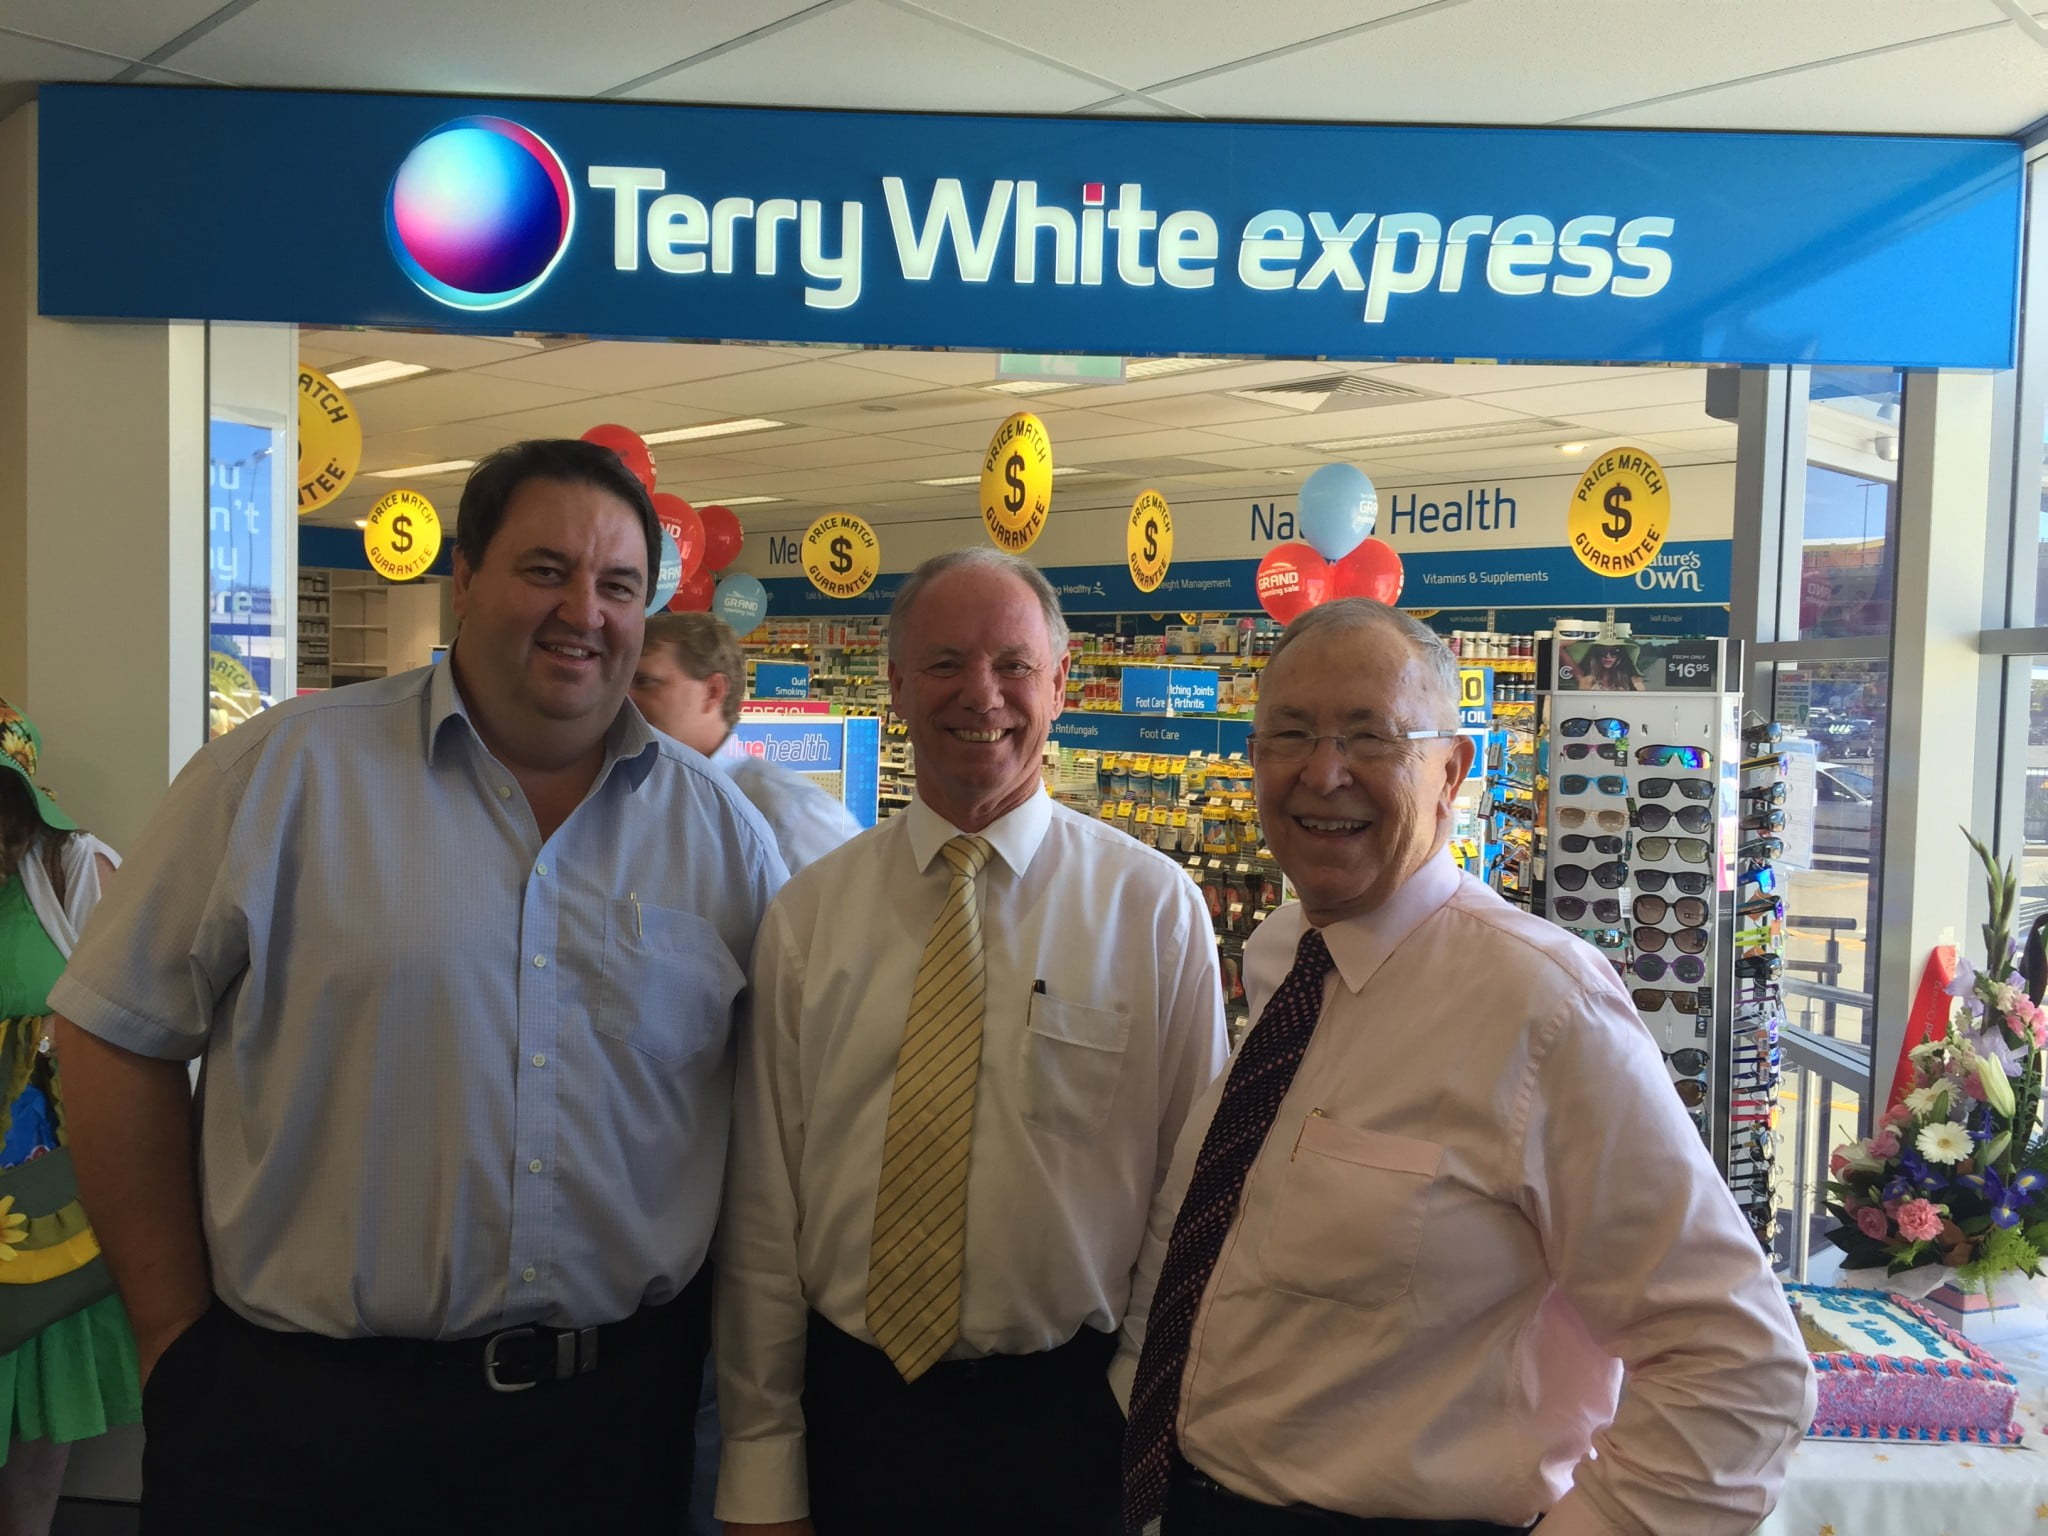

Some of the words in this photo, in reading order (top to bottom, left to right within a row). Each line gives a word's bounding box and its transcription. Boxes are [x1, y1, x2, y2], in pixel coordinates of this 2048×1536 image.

[588, 165, 863, 309] Terry
[882, 176, 1219, 289] White
[1238, 209, 1675, 323] express
[298, 373, 349, 424] ATCH
[986, 423, 1014, 472] PRICE
[1016, 420, 1046, 463] MATCH
[1004, 450, 1025, 516] $
[1577, 457, 1614, 502] PRICE
[1618, 455, 1662, 495] MATCH
[371, 494, 398, 524] PRICE
[401, 493, 433, 524] MATCH
[986, 496, 1045, 547] GUARANTEE
[1132, 495, 1151, 527] PRICE
[1152, 496, 1170, 533] MATCH
[1391, 487, 1516, 535] Health
[1601, 482, 1632, 542] $
[391, 513, 413, 555] $
[808, 517, 838, 545] PRICE
[841, 517, 874, 548] MATCH
[1144, 517, 1158, 564] $
[371, 545, 432, 575] GUARANTEE
[830, 535, 853, 575] $
[1575, 526, 1660, 570] GUARANTEE
[1649, 551, 1701, 568] ature's
[809, 565, 872, 594] GUARANTEE
[1063, 586, 1092, 595] Healthy
[1158, 579, 1180, 591] eight
[1181, 577, 1232, 590] Management
[1258, 572, 1299, 591] GRAND
[1284, 585, 1300, 594] sale
[1423, 573, 1467, 585] Vitamins
[1469, 572, 1478, 583] &
[1480, 570, 1549, 584] Supplements
[1635, 566, 1704, 592] Own
[724, 597, 759, 612] GRAND
[775, 687, 807, 698] Smoking
[791, 676, 807, 686] Quit
[1192, 685, 1215, 697] Joints
[1136, 697, 1150, 709] Foot
[1151, 698, 1166, 709] Care
[1174, 698, 1205, 710] Arthritis
[1467, 710, 1487, 724] OIL
[1055, 723, 1099, 737] Antifungals
[1140, 728, 1159, 739] Foot
[1161, 728, 1180, 740] Care
